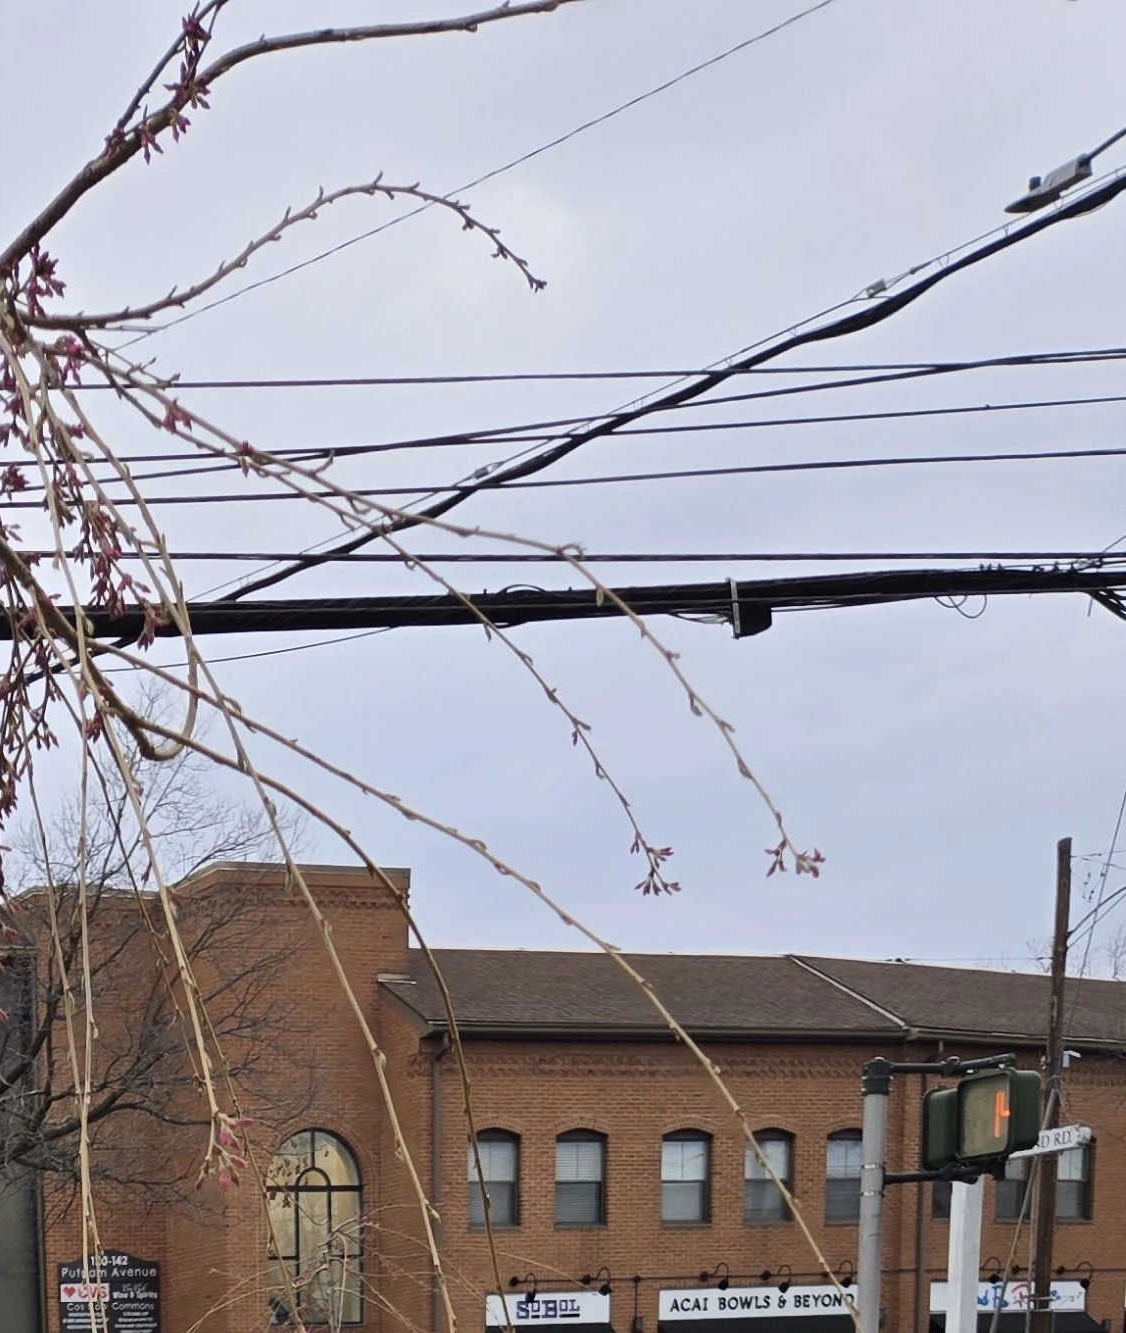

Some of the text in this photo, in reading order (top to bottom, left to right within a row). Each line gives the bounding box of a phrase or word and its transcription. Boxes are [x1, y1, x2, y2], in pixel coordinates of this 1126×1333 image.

[1053, 1130, 1073, 1147] RD.
[90, 1255, 128, 1266] 10-142
[61, 1267, 157, 1278] Putam Avenue
[77, 1285, 108, 1299] CVS
[66, 1301, 85, 1312] Cos
[111, 1301, 155, 1311] Commons
[669, 1292, 856, 1312] ACAI BOWLS & BEYOND
